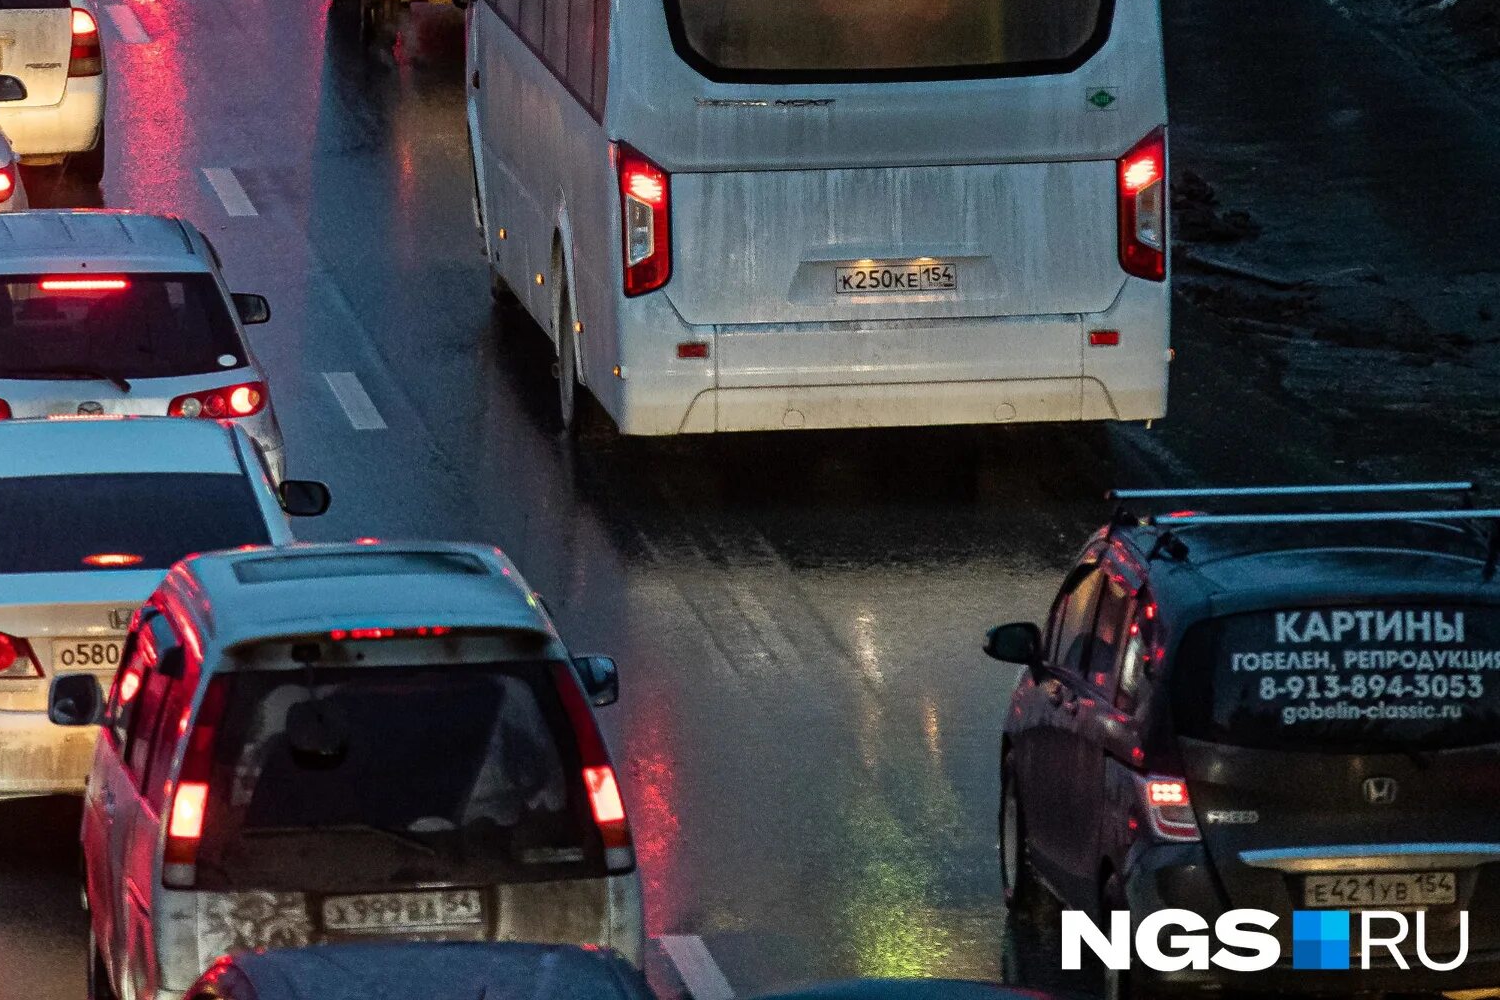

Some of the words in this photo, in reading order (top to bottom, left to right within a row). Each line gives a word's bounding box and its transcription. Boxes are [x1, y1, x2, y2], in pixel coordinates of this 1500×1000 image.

[842, 269, 918, 290] К250КЕ
[922, 266, 954, 283] 154
[1274, 610, 1465, 643] КАРТИНЫ
[1231, 651, 1338, 672] ГОБЕЛЕН,
[1258, 674, 1485, 700] 8-913-894-3053
[1281, 701, 1463, 725] gobelin-classic.ru
[1314, 877, 1409, 903] Е421УВ
[1414, 872, 1453, 893] 154
